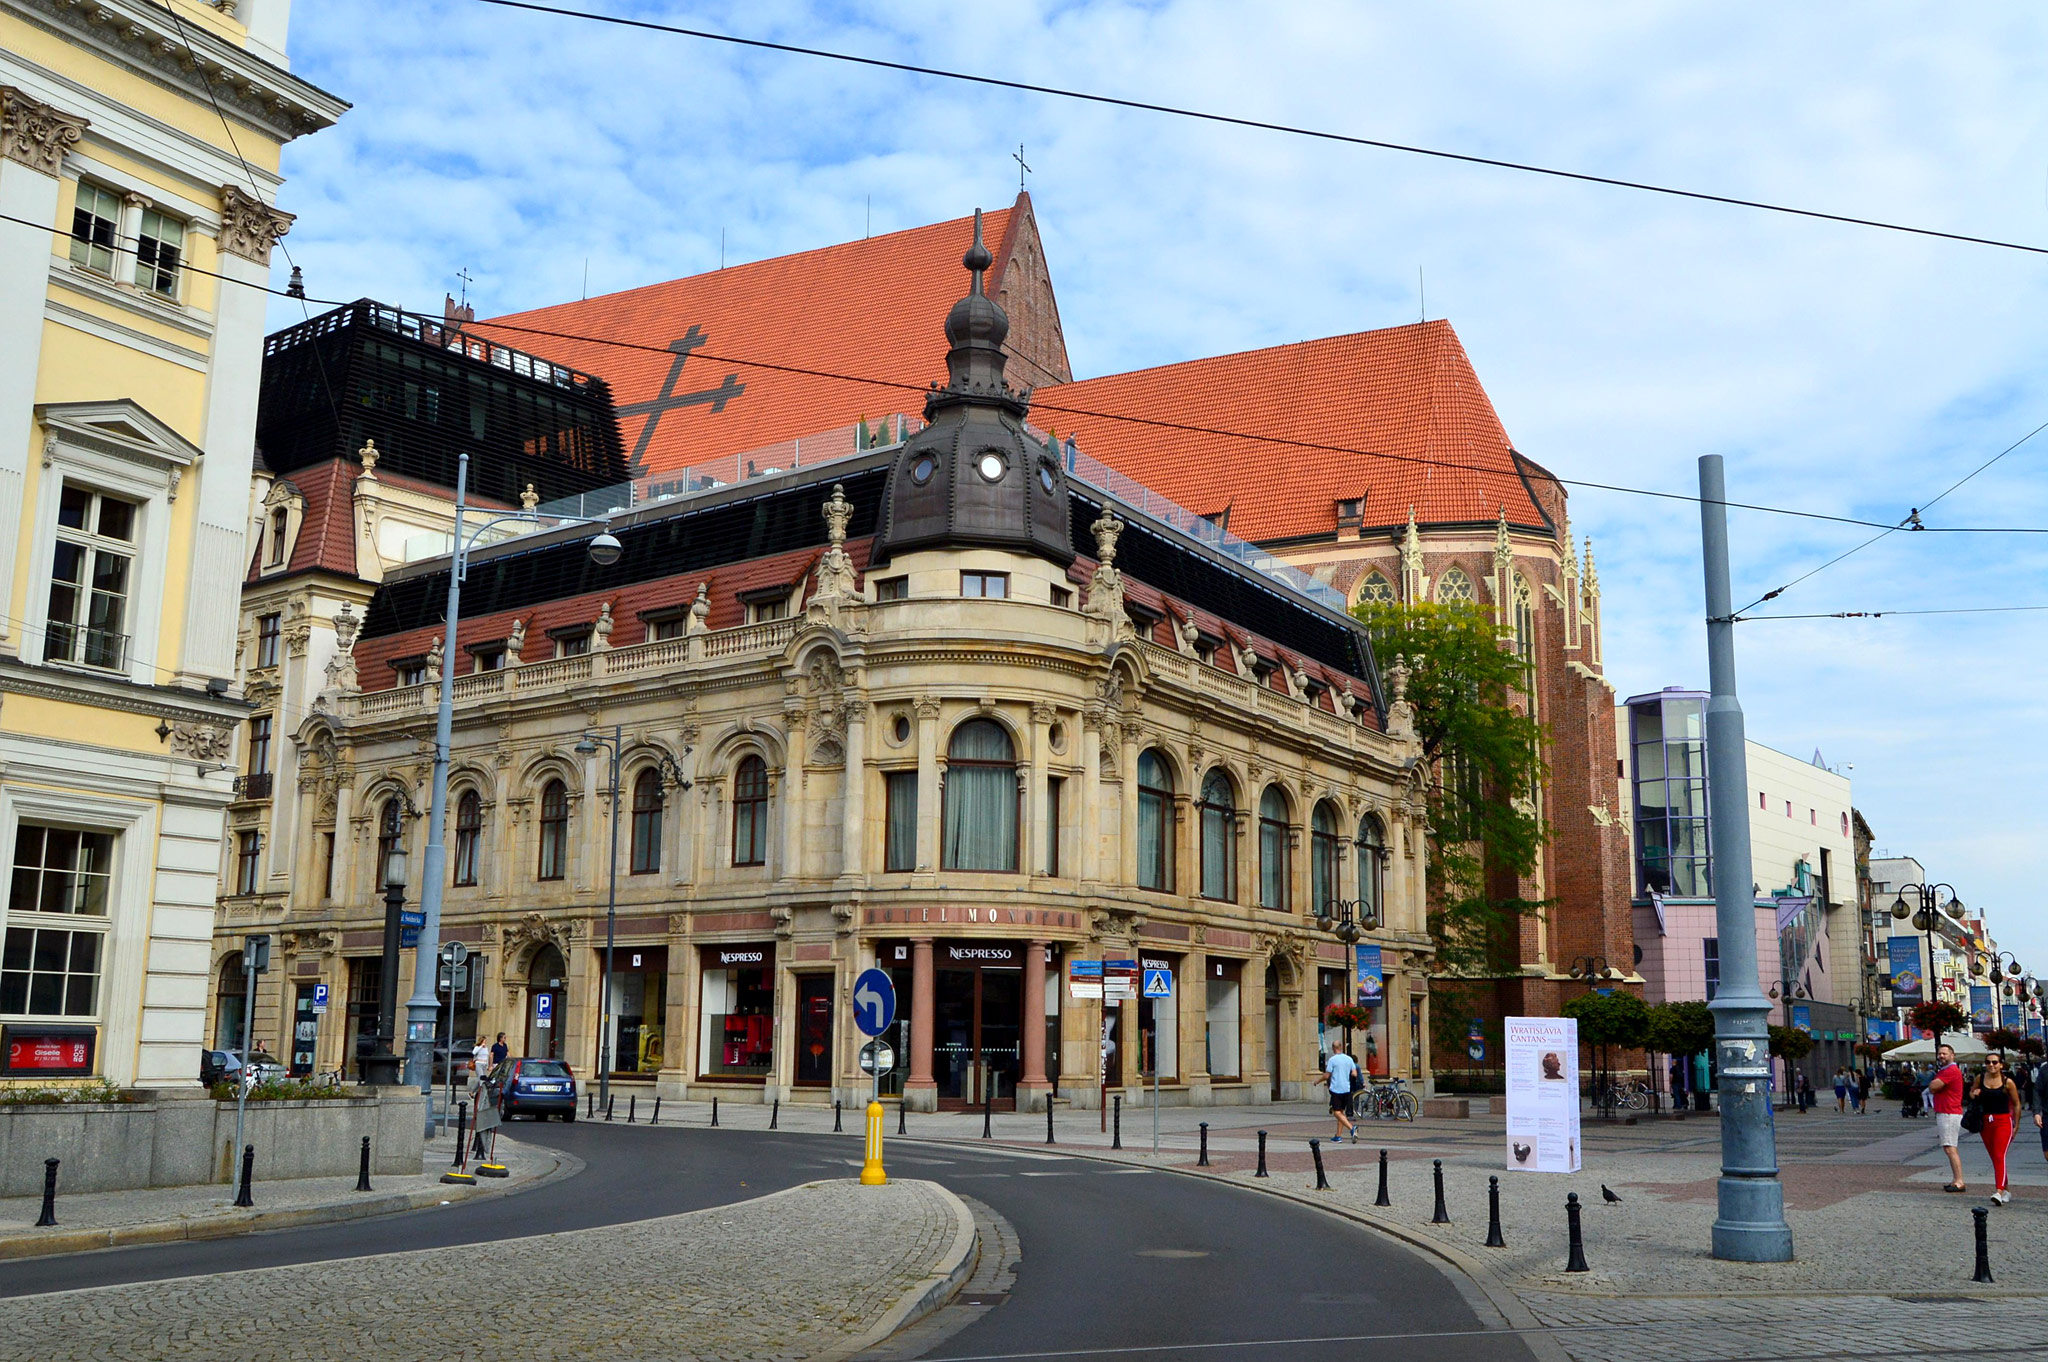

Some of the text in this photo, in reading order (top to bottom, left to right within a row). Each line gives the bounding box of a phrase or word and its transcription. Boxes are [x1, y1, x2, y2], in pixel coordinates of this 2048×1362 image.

[720, 952, 763, 964] NESPRESSO
[949, 946, 1012, 960] NESPRESSO
[1142, 957, 1169, 970] NESPRESSO
[316, 986, 327, 1000] P
[540, 996, 550, 1012] P
[1510, 1026, 1562, 1035] WRATISLAVIA
[1510, 1035, 1547, 1043] CANTANS
